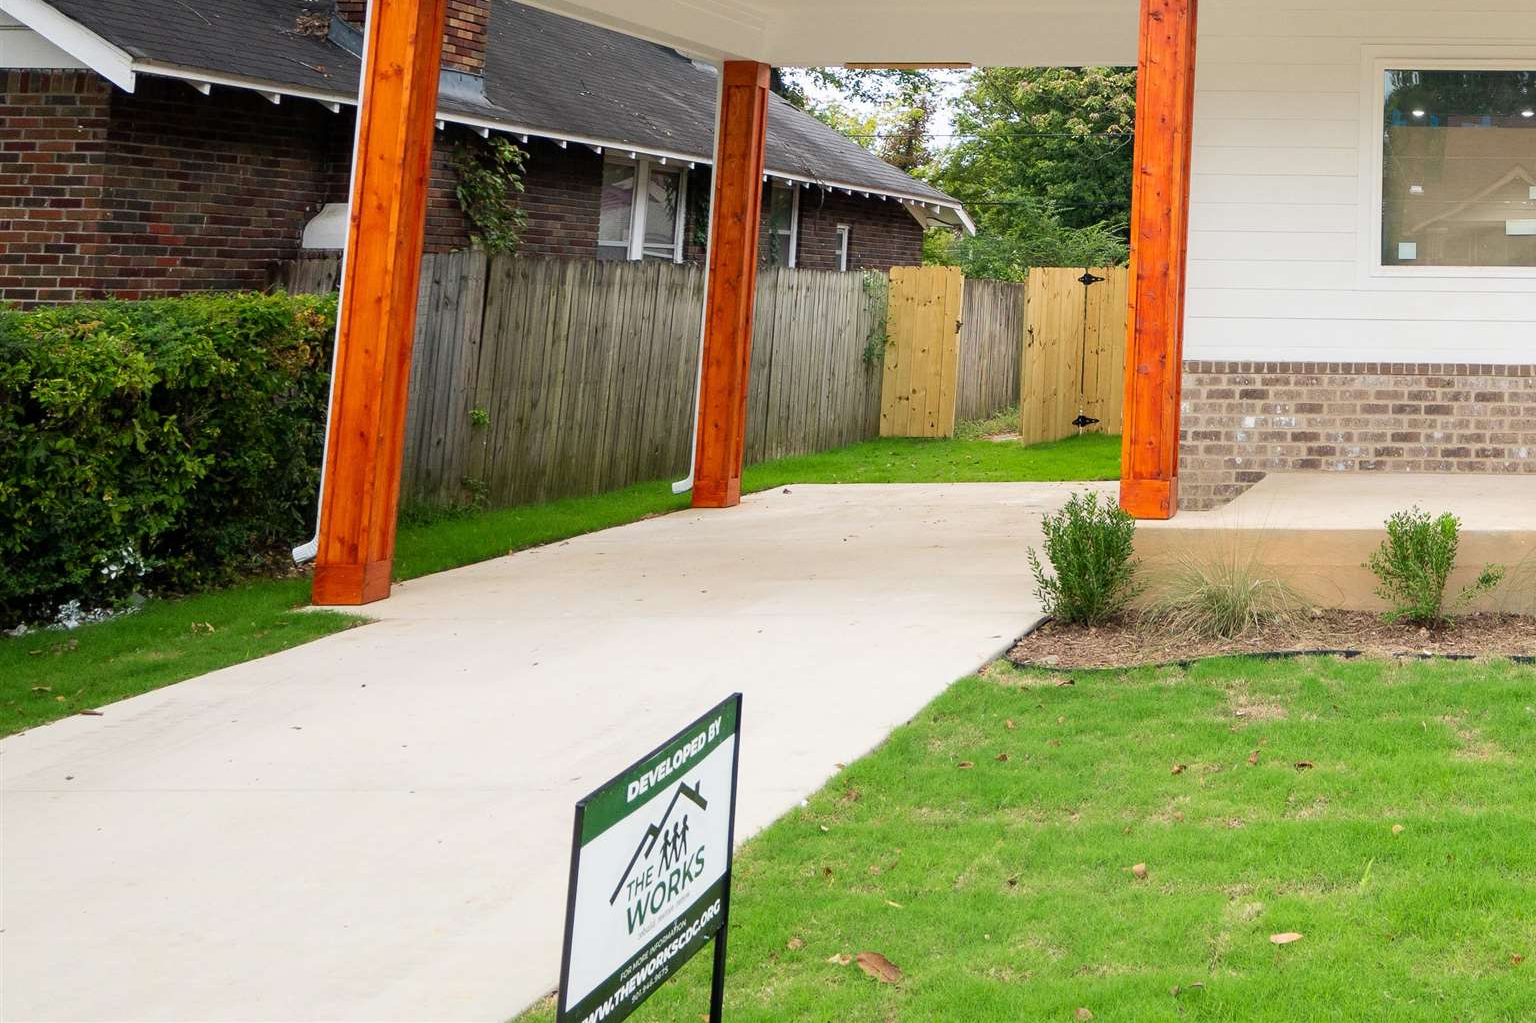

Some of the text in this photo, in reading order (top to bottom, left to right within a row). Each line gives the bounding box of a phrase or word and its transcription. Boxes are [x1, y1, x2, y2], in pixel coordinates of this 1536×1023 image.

[626, 715, 722, 803] DEVELOPED BY
[626, 864, 654, 902] THE
[626, 844, 705, 935] WORKS
[619, 918, 687, 982] FOR MORE INFORMATION
